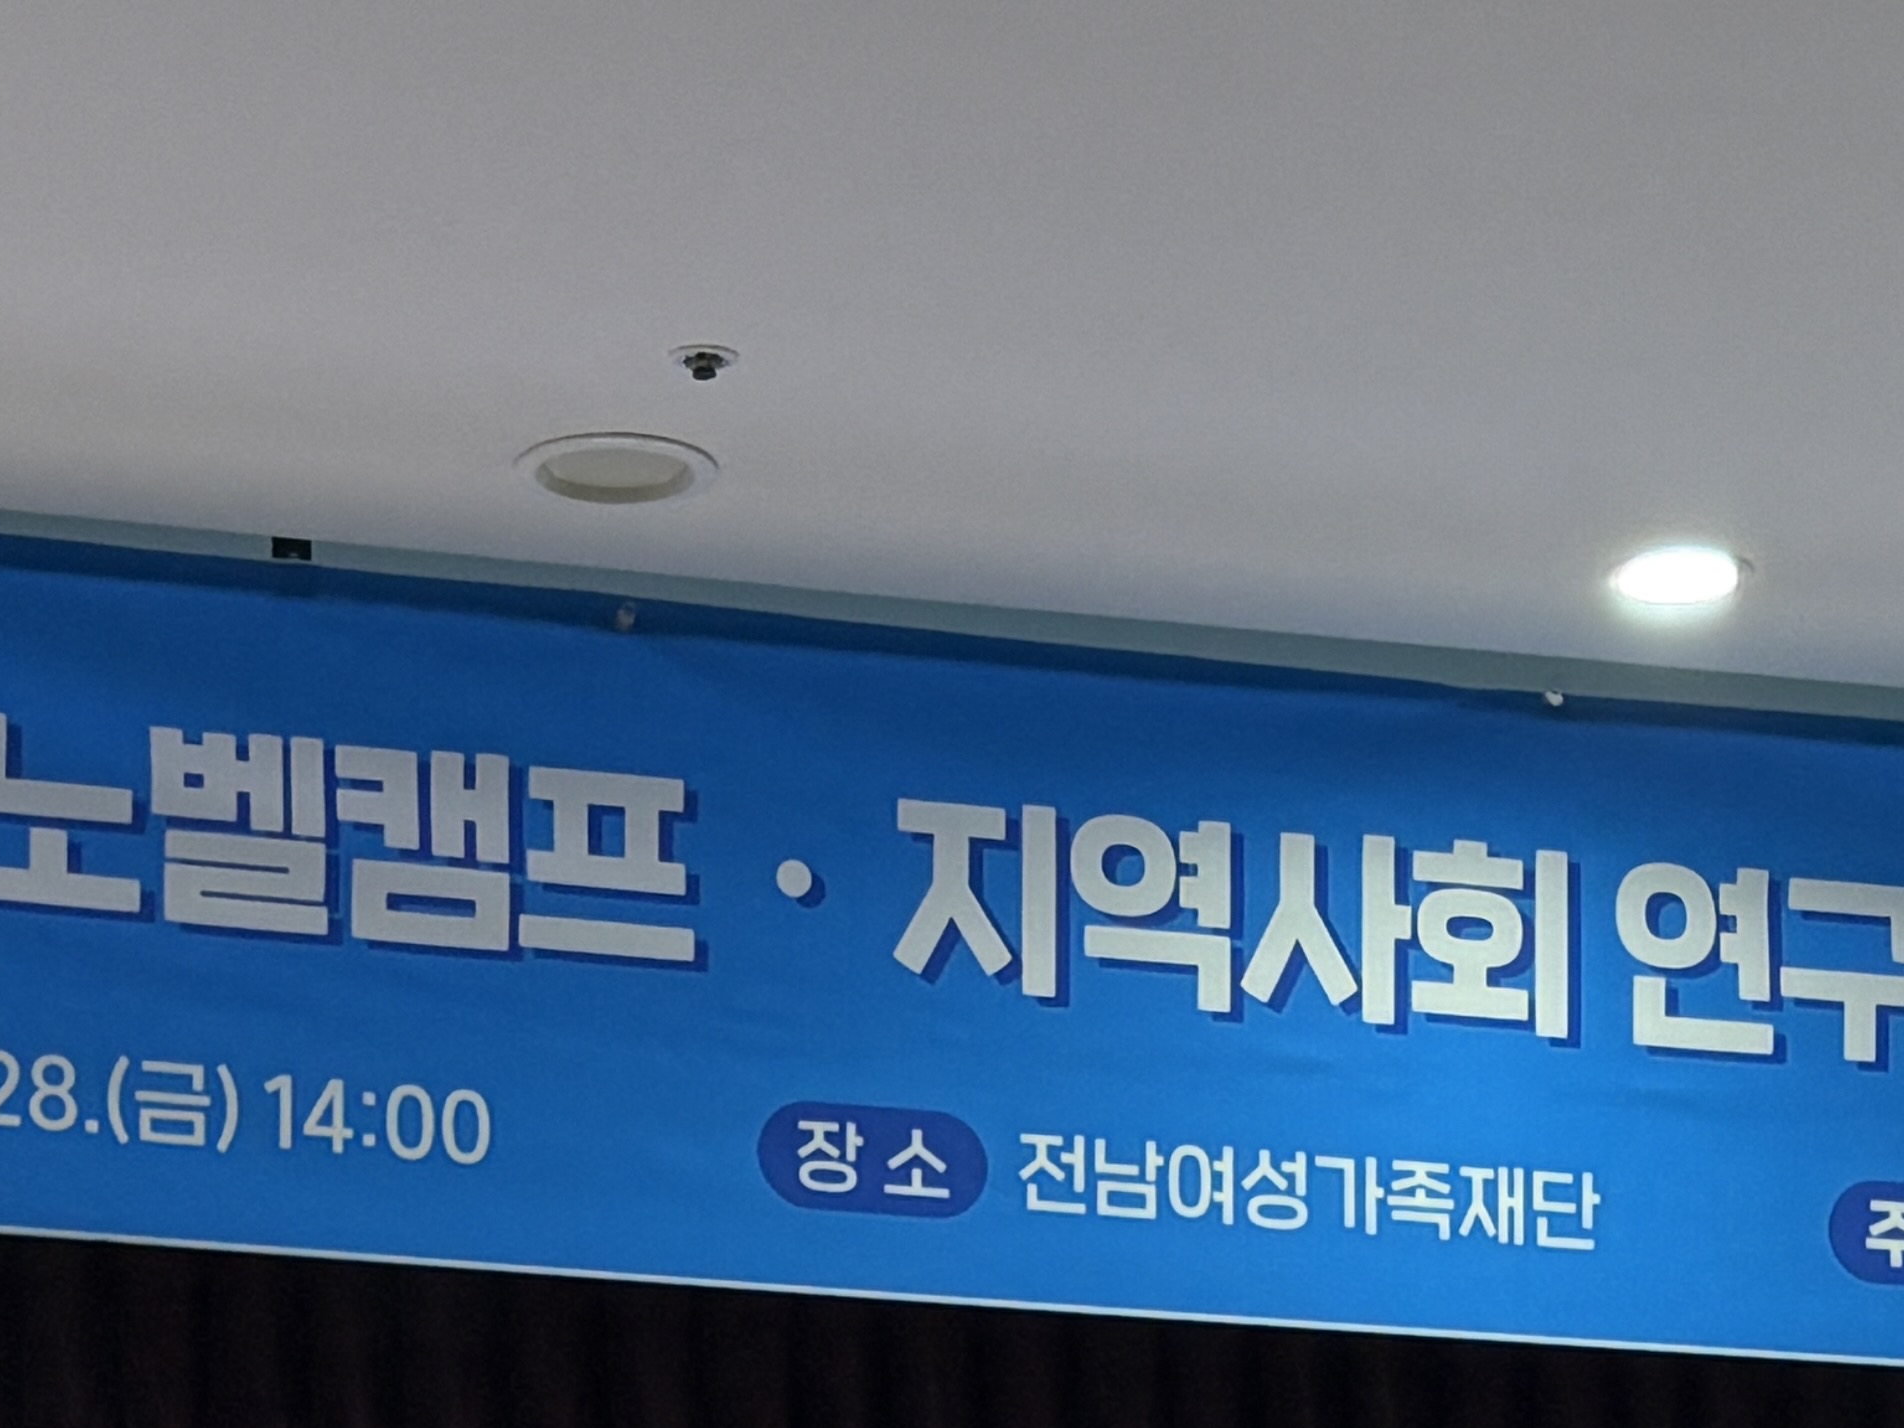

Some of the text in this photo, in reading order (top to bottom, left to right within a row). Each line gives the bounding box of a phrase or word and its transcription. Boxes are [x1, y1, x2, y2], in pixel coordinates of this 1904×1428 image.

[894, 800, 1568, 1038] 지역사회
[265, 1075, 490, 1164] 14:00
[1020, 1134, 1600, 1250] 전남여성가족재단
